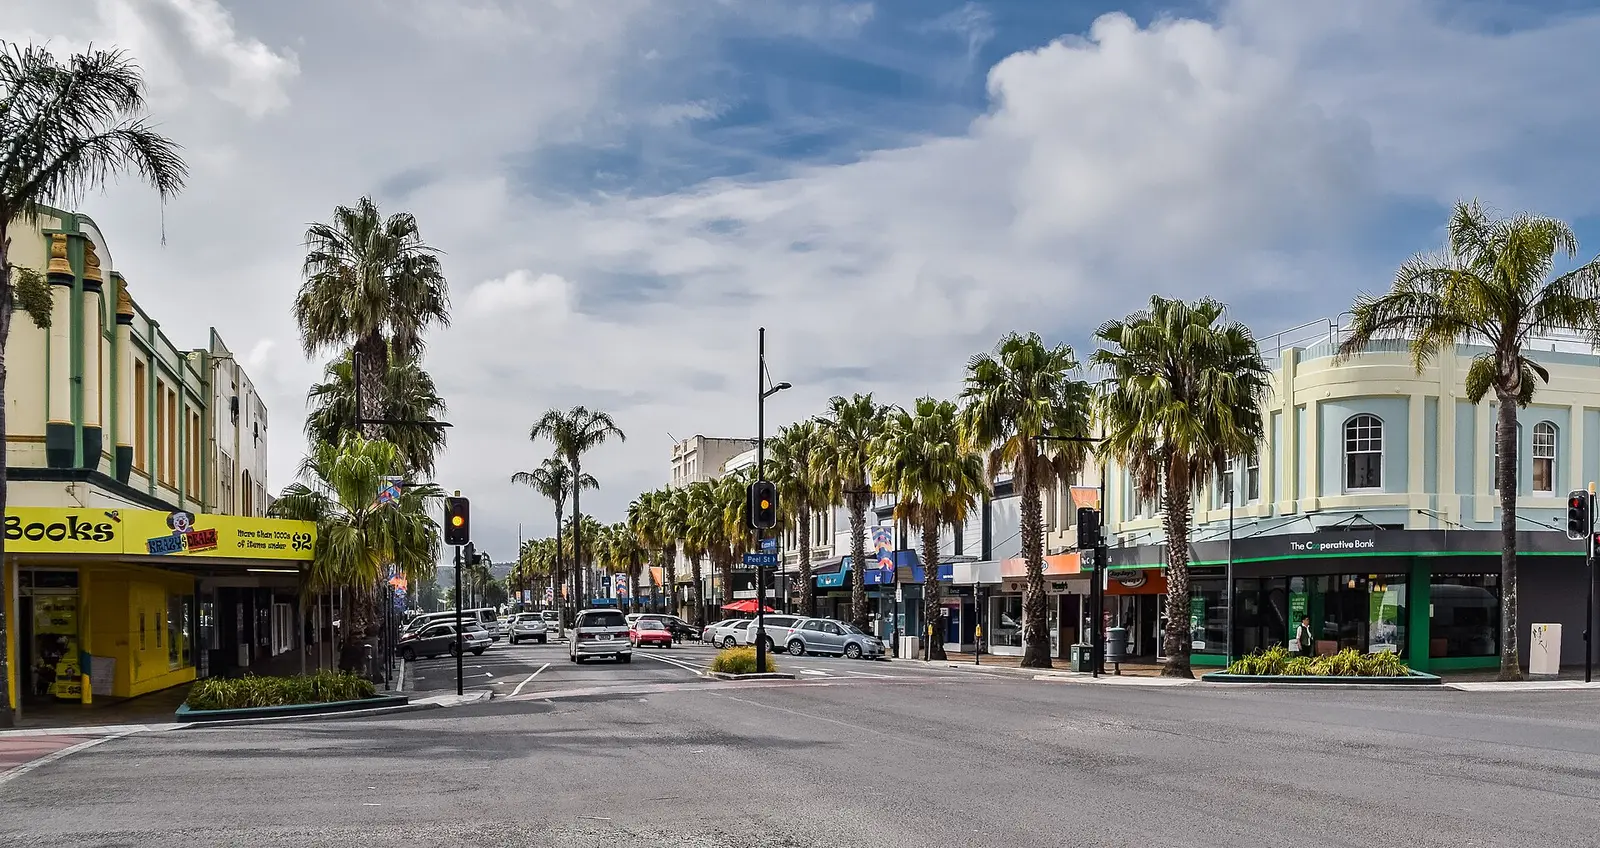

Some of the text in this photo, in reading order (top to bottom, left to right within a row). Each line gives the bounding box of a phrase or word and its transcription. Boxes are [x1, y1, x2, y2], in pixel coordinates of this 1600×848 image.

[4, 516, 114, 542] Books
[237, 529, 291, 540] More than 1000s
[237, 540, 286, 550] of items under
[292, 531, 312, 552] $2
[1290, 541, 1305, 550] The
[1354, 539, 1374, 548] Bank
